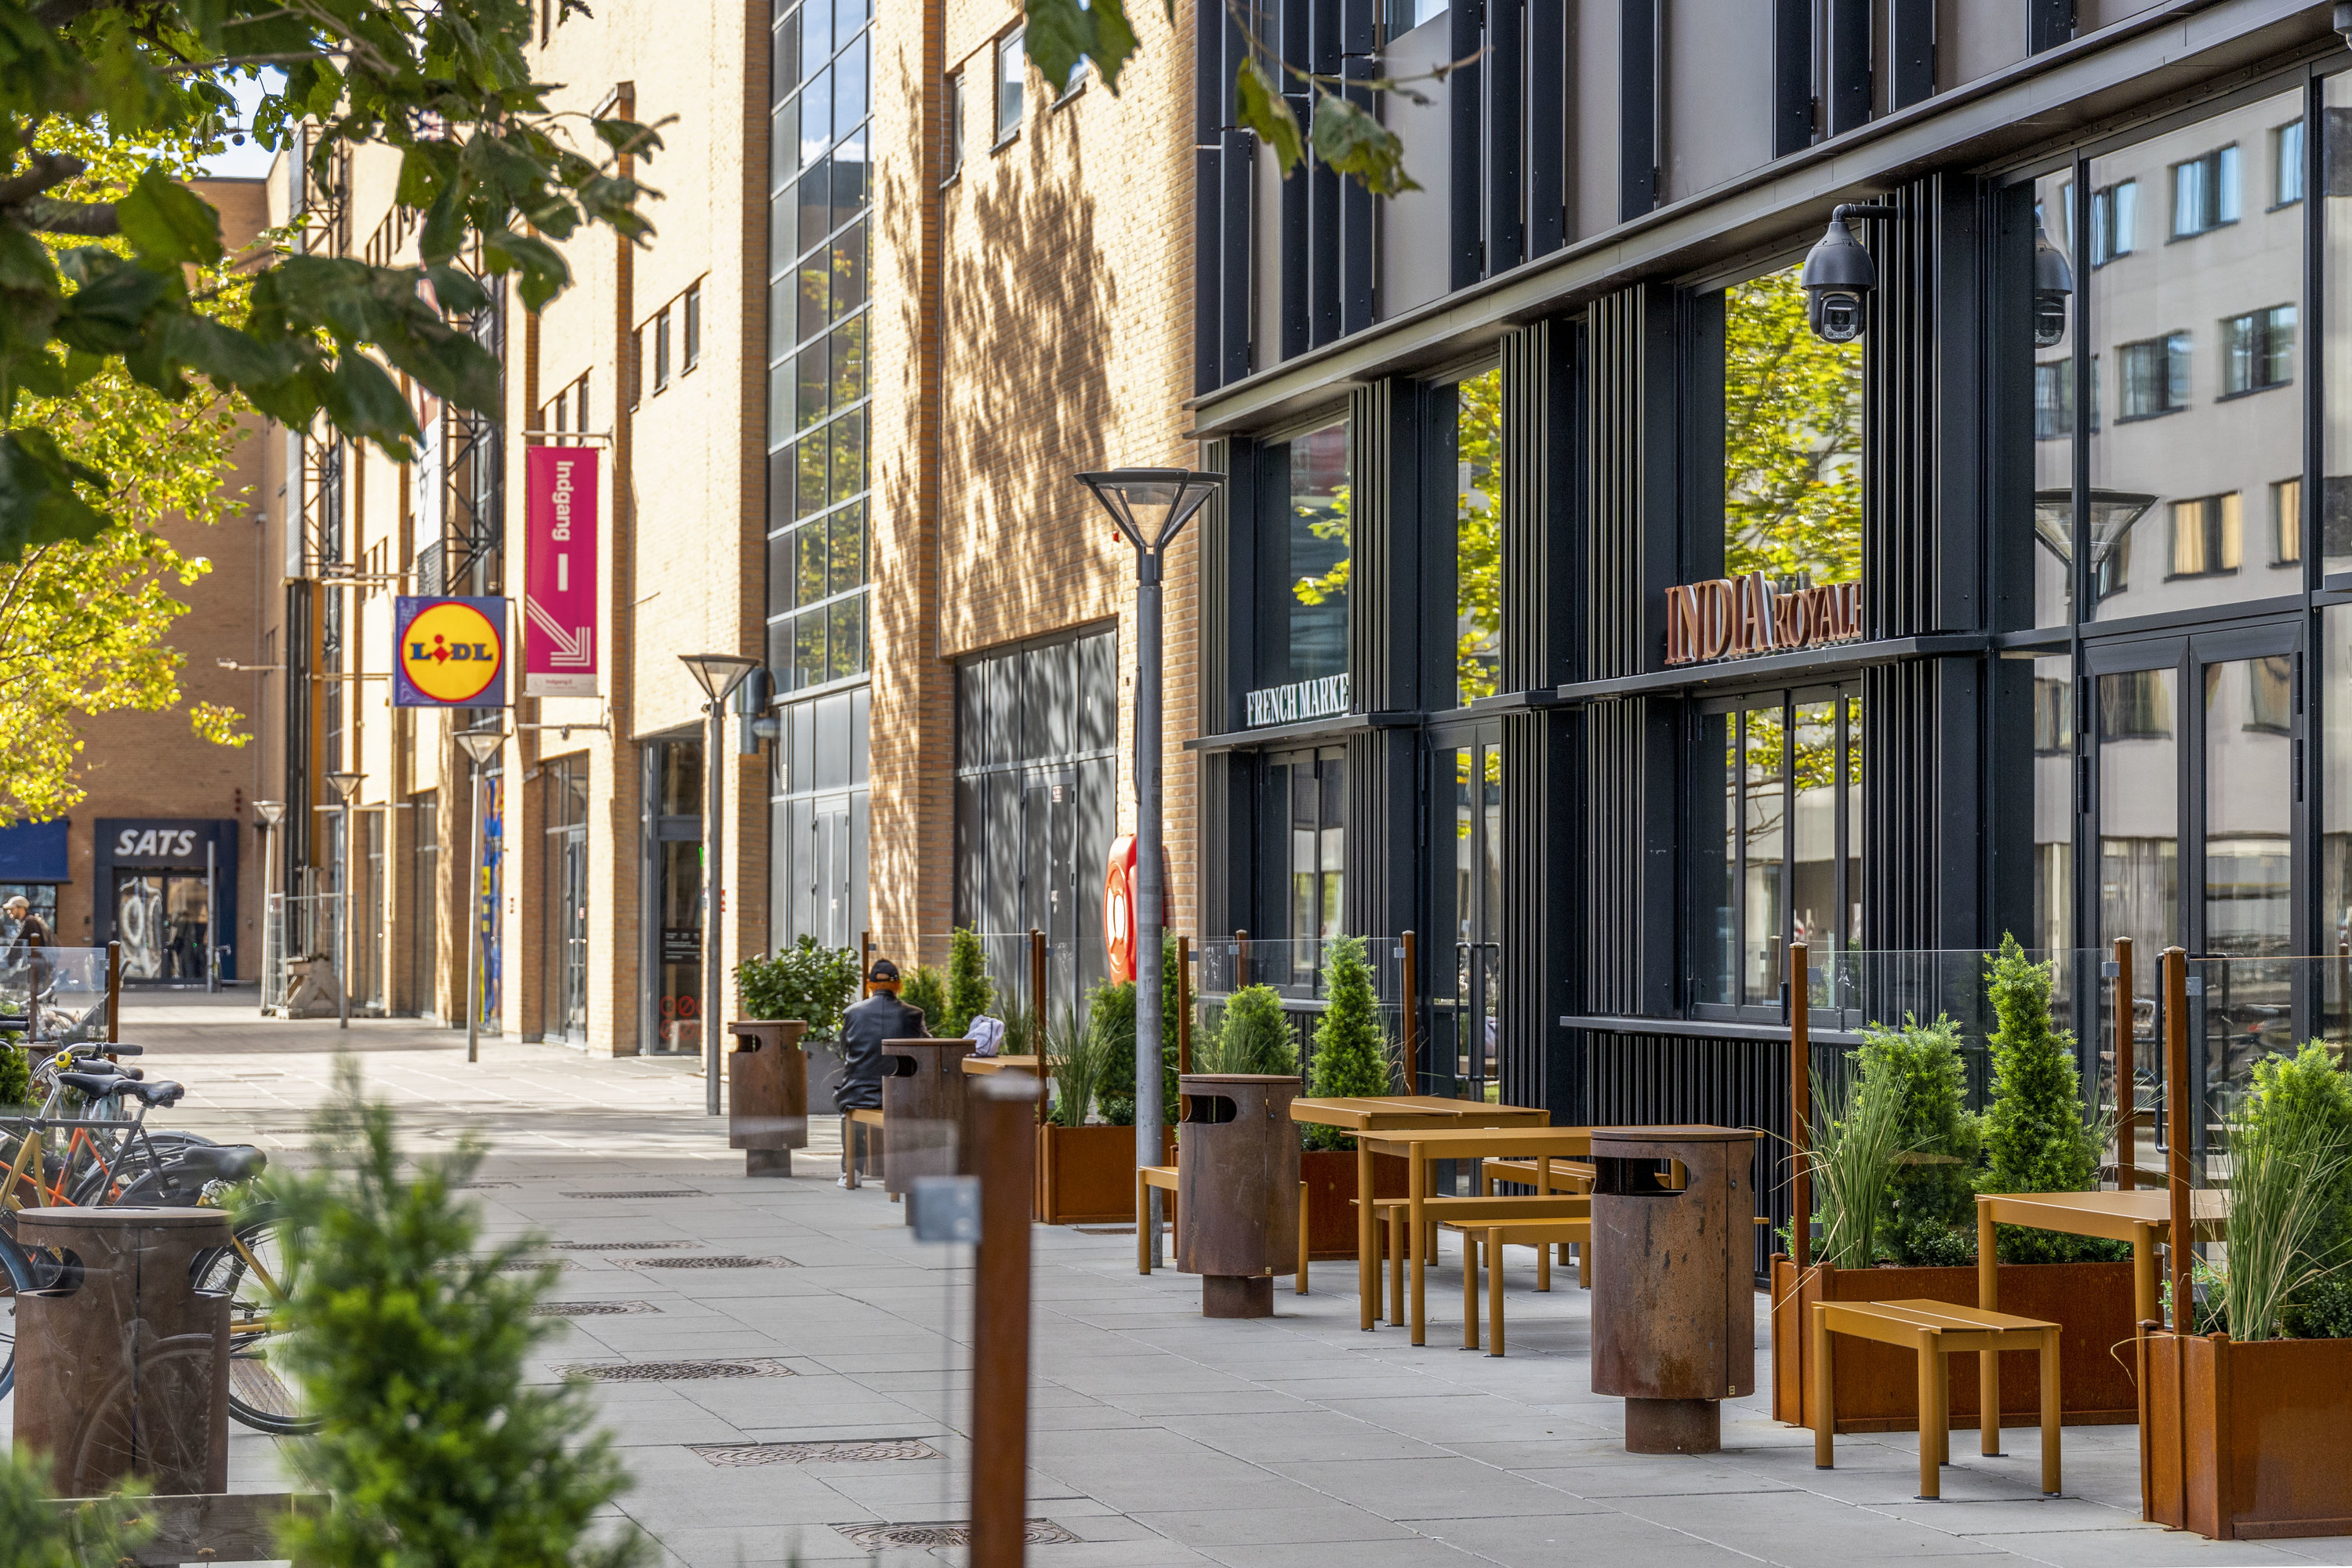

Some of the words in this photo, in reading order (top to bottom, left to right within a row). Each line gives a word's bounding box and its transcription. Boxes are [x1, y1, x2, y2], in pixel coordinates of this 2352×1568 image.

[552, 461, 574, 541] Indgang
[1664, 571, 1773, 665] INDIA
[1246, 684, 1298, 727] FRENCH
[1298, 672, 1348, 719] MARKE
[114, 829, 197, 857] SATS
